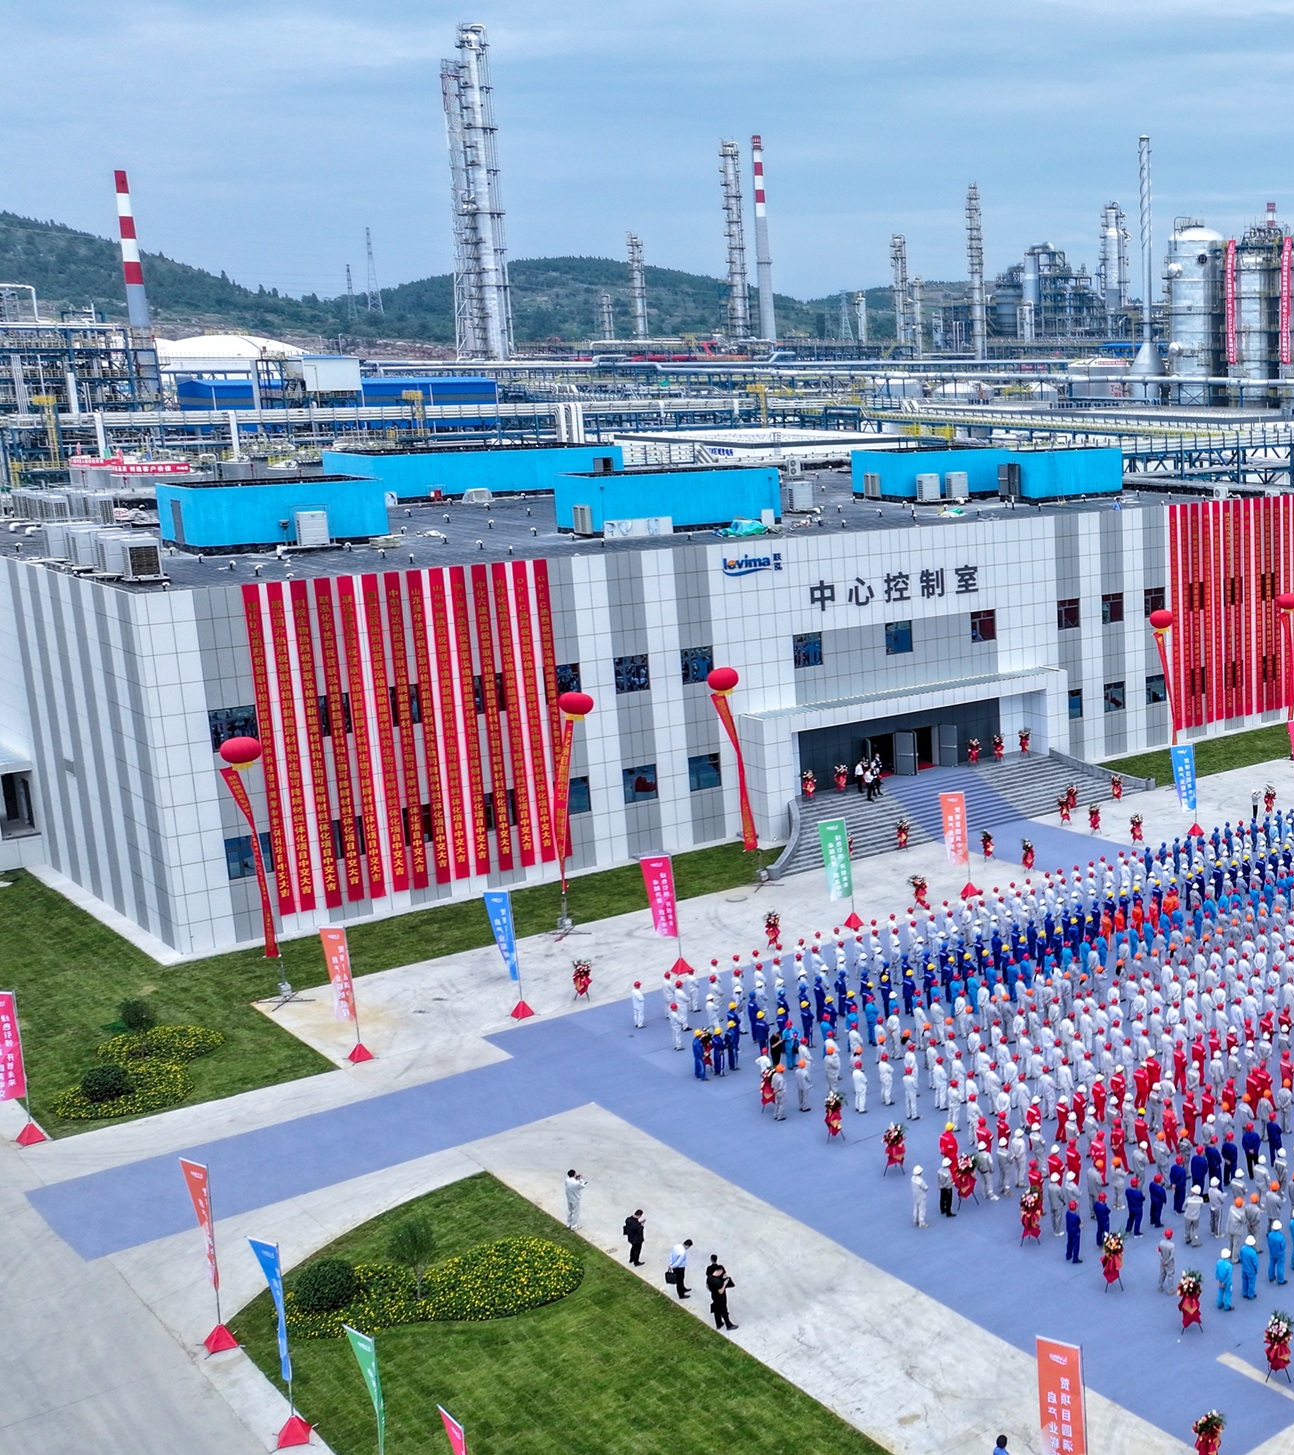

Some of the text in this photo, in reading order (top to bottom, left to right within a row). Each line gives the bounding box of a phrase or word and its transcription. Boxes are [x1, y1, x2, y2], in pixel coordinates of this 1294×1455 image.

[723, 554, 771, 573] levima
[810, 564, 979, 612] 中心控制室
